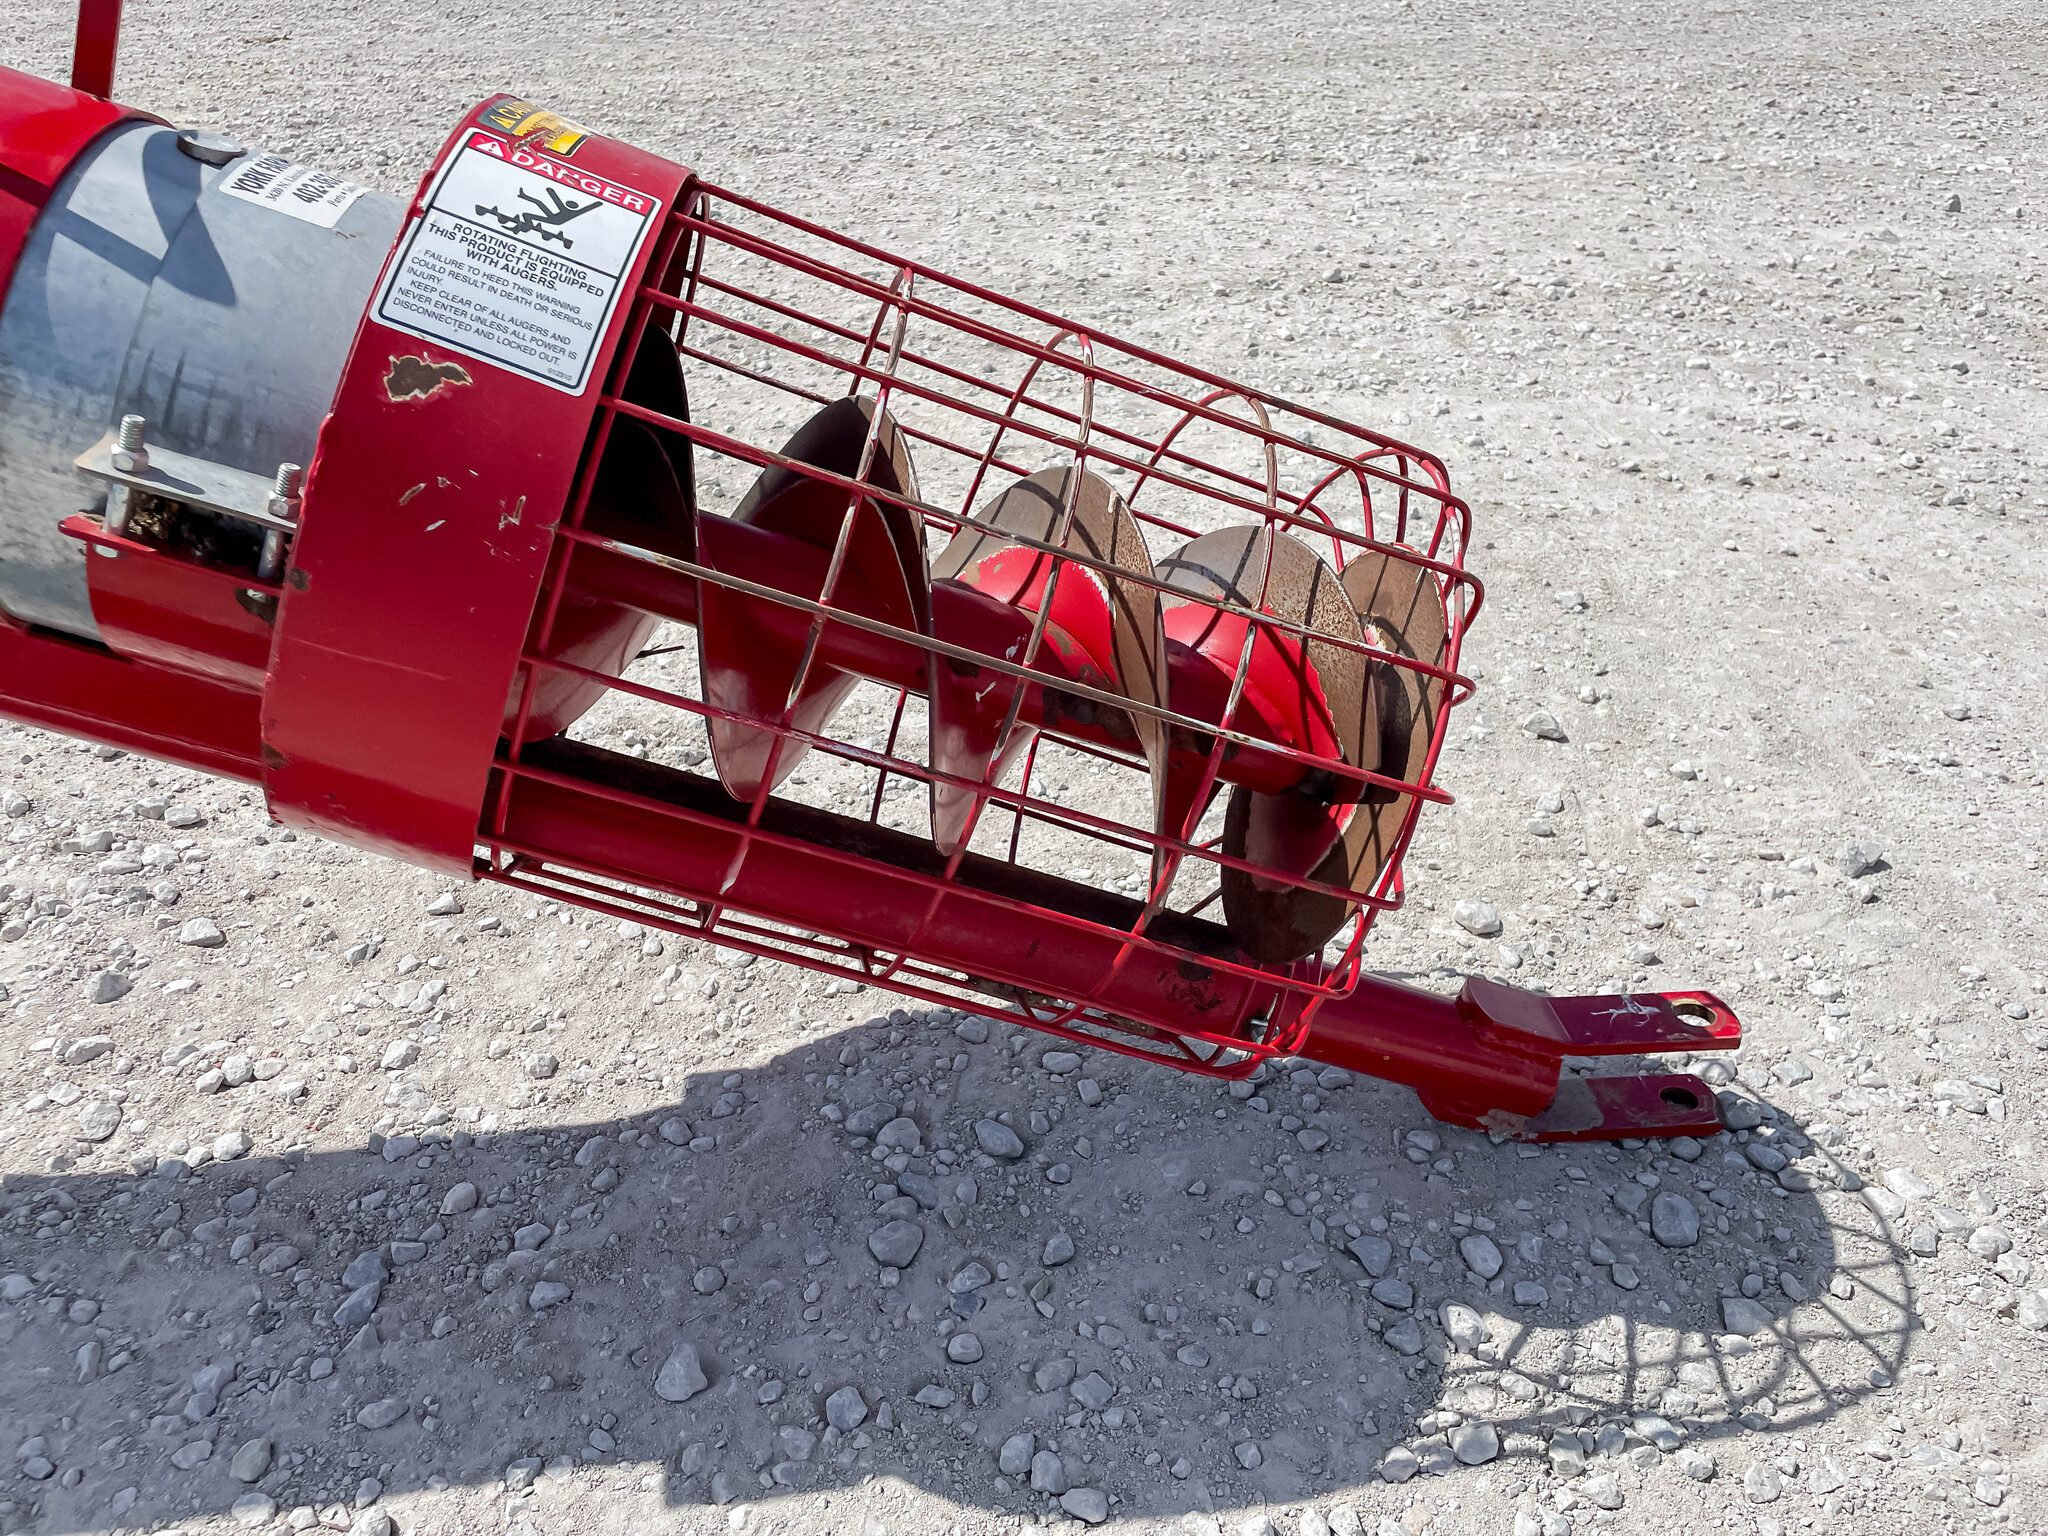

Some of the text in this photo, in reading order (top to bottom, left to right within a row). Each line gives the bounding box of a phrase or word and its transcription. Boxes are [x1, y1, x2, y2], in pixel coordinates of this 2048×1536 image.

[231, 167, 276, 195] YORK
[511, 151, 645, 211] DANGER
[407, 266, 443, 286] INJURY.
[424, 249, 581, 315] FAILURE TO HEED THIS WARNING
[429, 223, 604, 297] THIS PRODUCT IS EQUIPPED
[453, 223, 587, 281] ROTATING FLIGHTING
[466, 249, 558, 291] WITH AUGERS.
[397, 287, 578, 361] NEVER ENTER UNLESS ALL POWER IS
[410, 279, 571, 346] KEEP CLEAR OF ALL AUGERS AND
[411, 256, 593, 331] COULD RESULT IN DEATH OR SERIOUS
[392, 296, 561, 366] DISCONNECTED AND LOCKED OUT.
